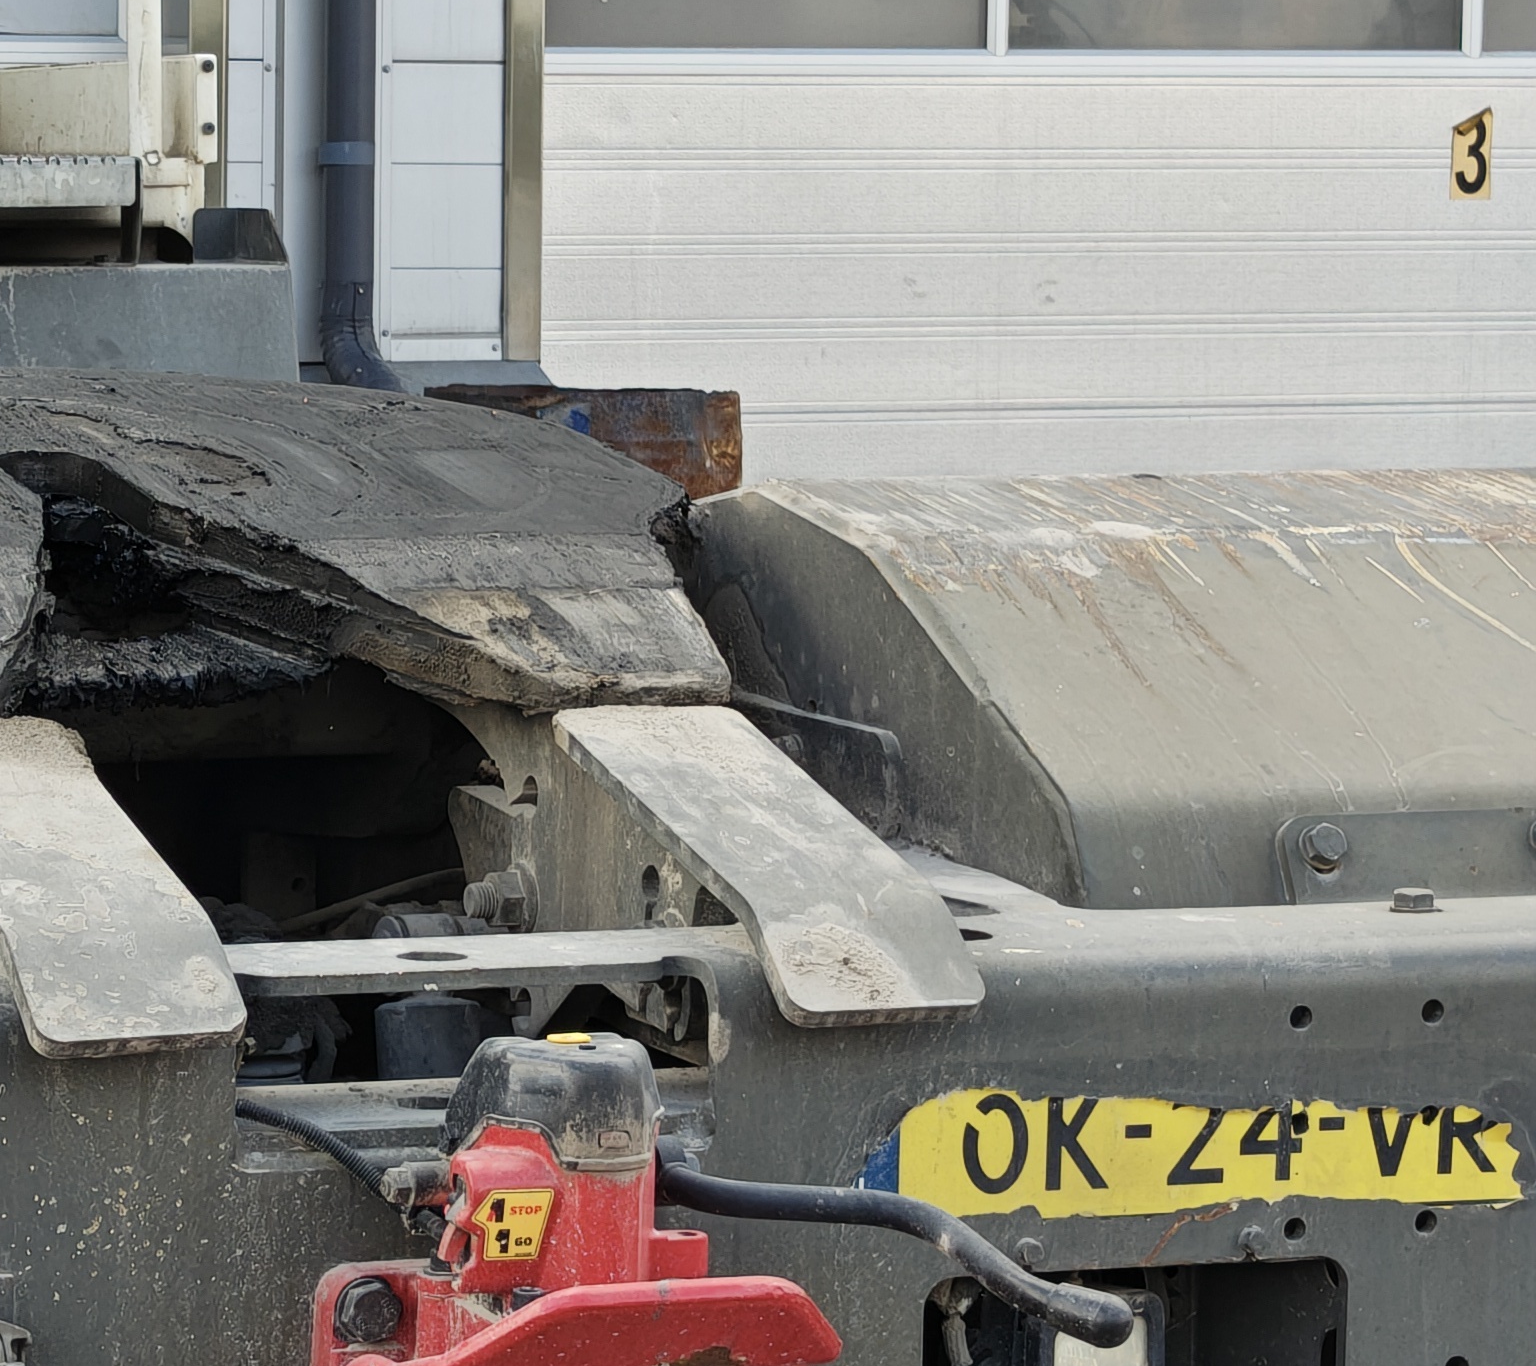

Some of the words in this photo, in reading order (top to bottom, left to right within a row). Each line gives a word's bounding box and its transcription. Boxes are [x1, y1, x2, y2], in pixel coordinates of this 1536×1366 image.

[1455, 118, 1487, 194] 3
[962, 1092, 1497, 1195] OK-24-VR
[509, 1205, 543, 1216] STOP
[514, 1237, 533, 1247] GO
